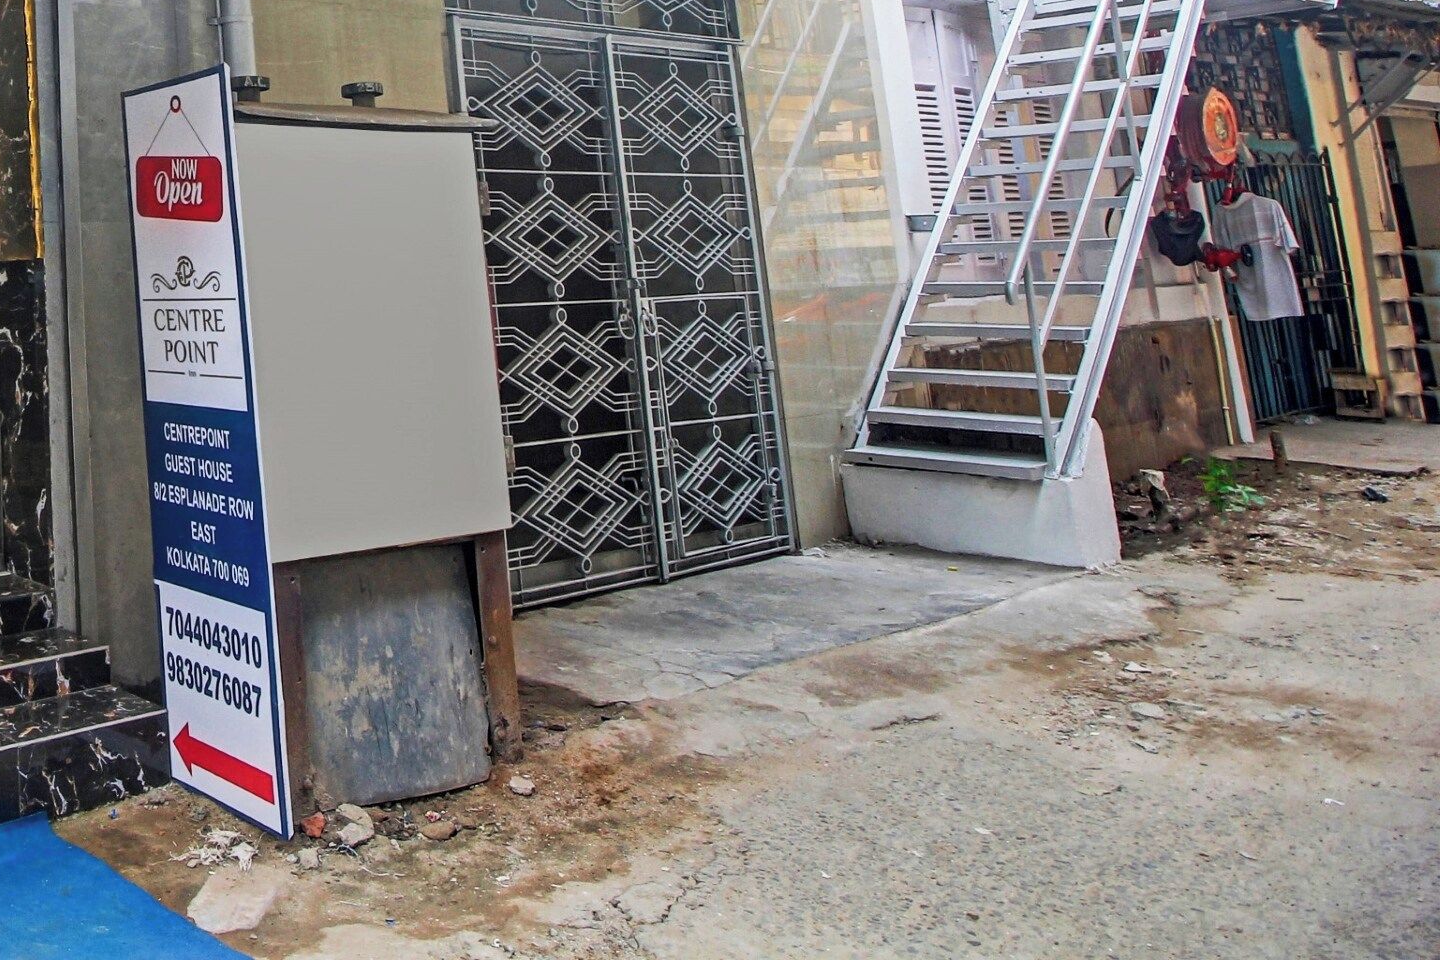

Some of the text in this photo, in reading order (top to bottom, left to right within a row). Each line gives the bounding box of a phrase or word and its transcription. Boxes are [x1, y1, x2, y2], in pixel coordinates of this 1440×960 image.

[171, 158, 198, 180] NOW
[153, 170, 203, 212] Open
[153, 308, 226, 332] CENTRE
[163, 339, 219, 364] POINT
[163, 422, 230, 450] CENTREPOINT
[164, 452, 234, 483] GUEST HOUSE
[168, 484, 227, 515] ESPLANADE
[228, 496, 254, 521] ROW
[190, 520, 216, 545] EAST
[166, 546, 250, 588] KOLKATA 700 069
[165, 606, 262, 669] 7044043010
[166, 651, 262, 718] 9830276087
